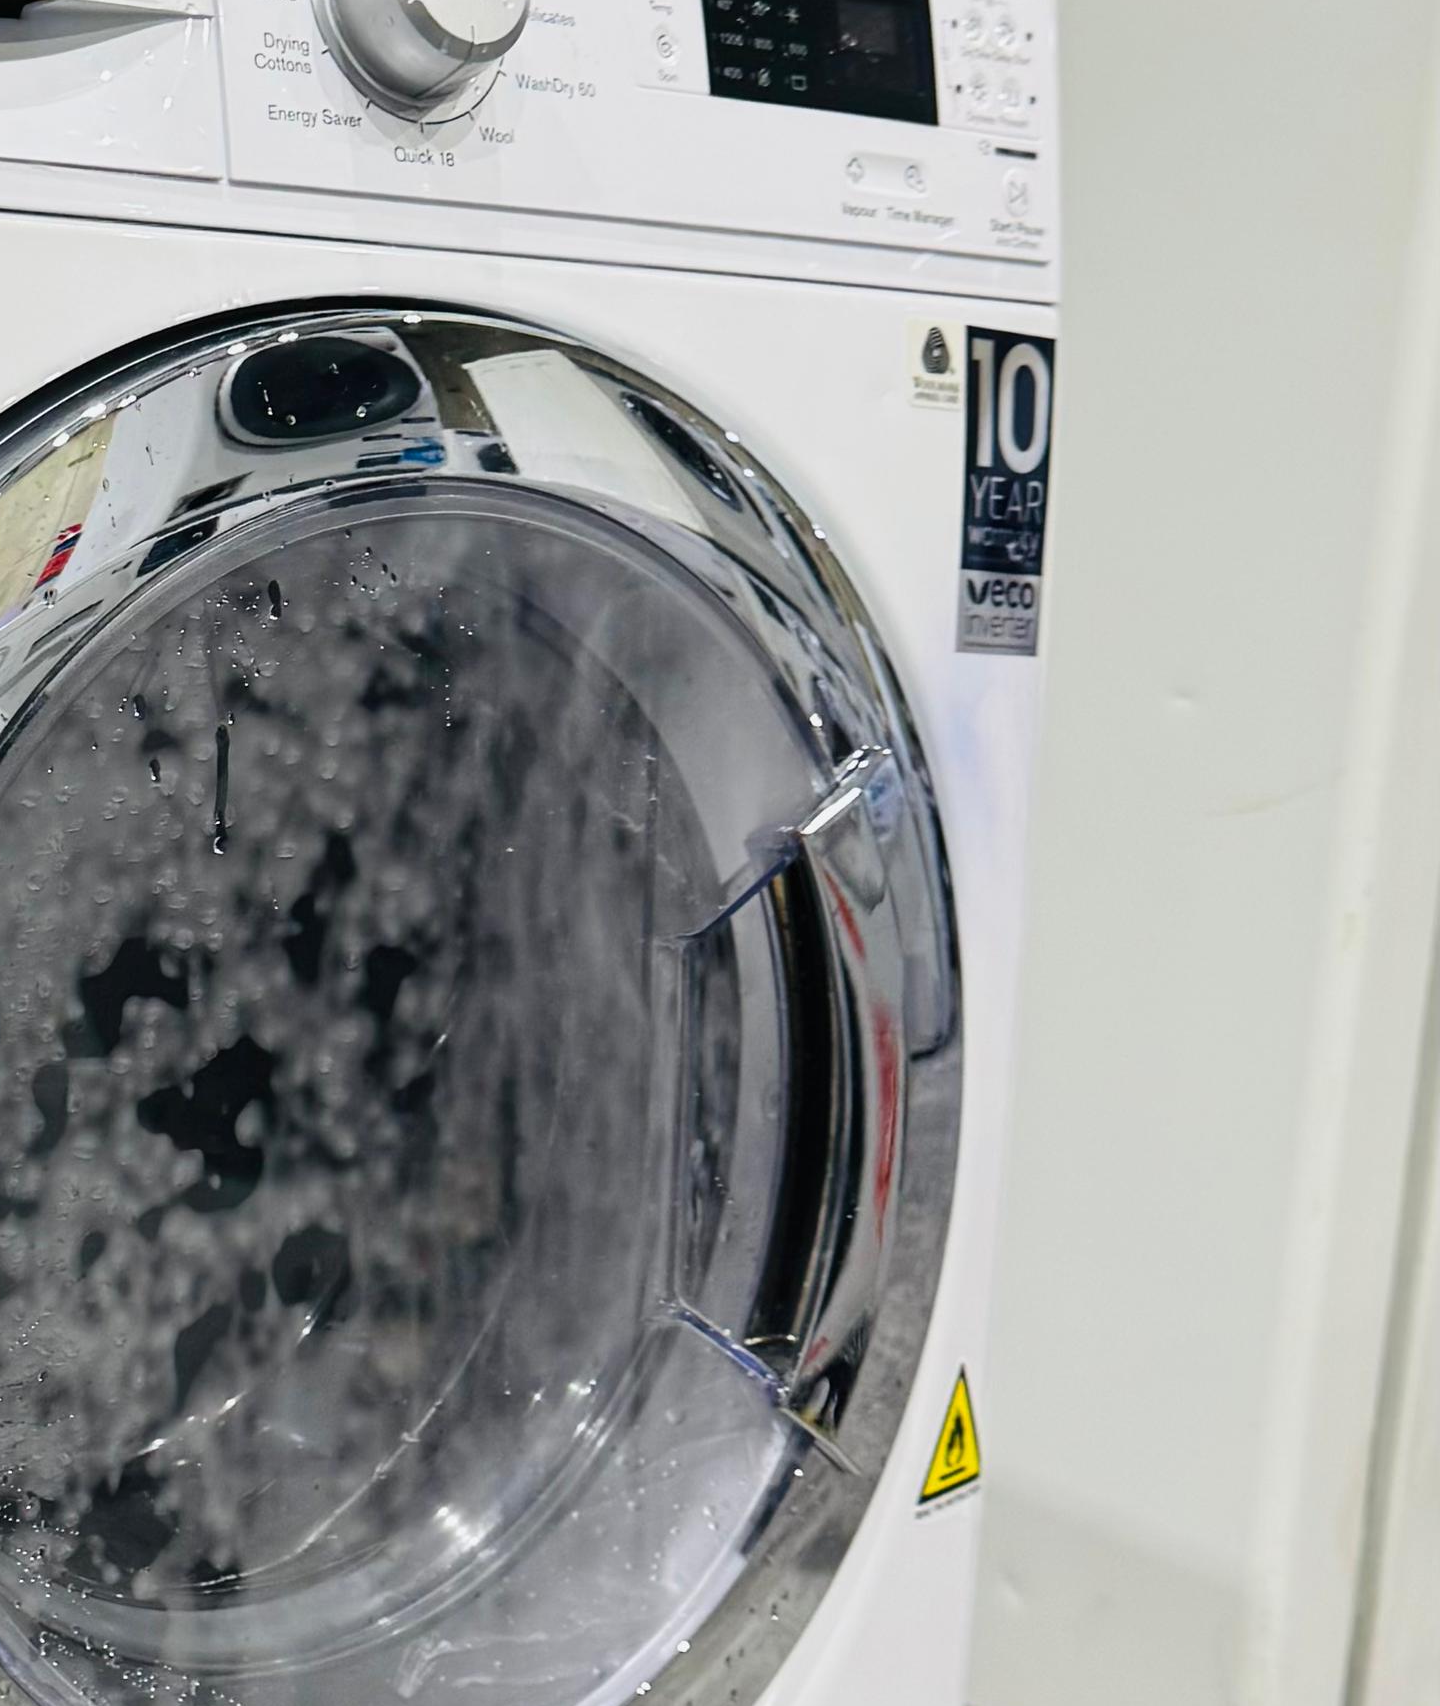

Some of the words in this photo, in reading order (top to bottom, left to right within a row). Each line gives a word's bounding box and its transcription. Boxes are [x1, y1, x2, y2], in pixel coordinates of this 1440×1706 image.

[263, 32, 310, 57] Drying
[254, 53, 312, 75] Cottons
[268, 104, 318, 128] Energy
[322, 109, 363, 128] Saver
[479, 126, 514, 145] Wool
[394, 146, 433, 167] Quick
[439, 150, 455, 167] 18
[972, 337, 1050, 475] 10
[969, 473, 1044, 524] YEAR
